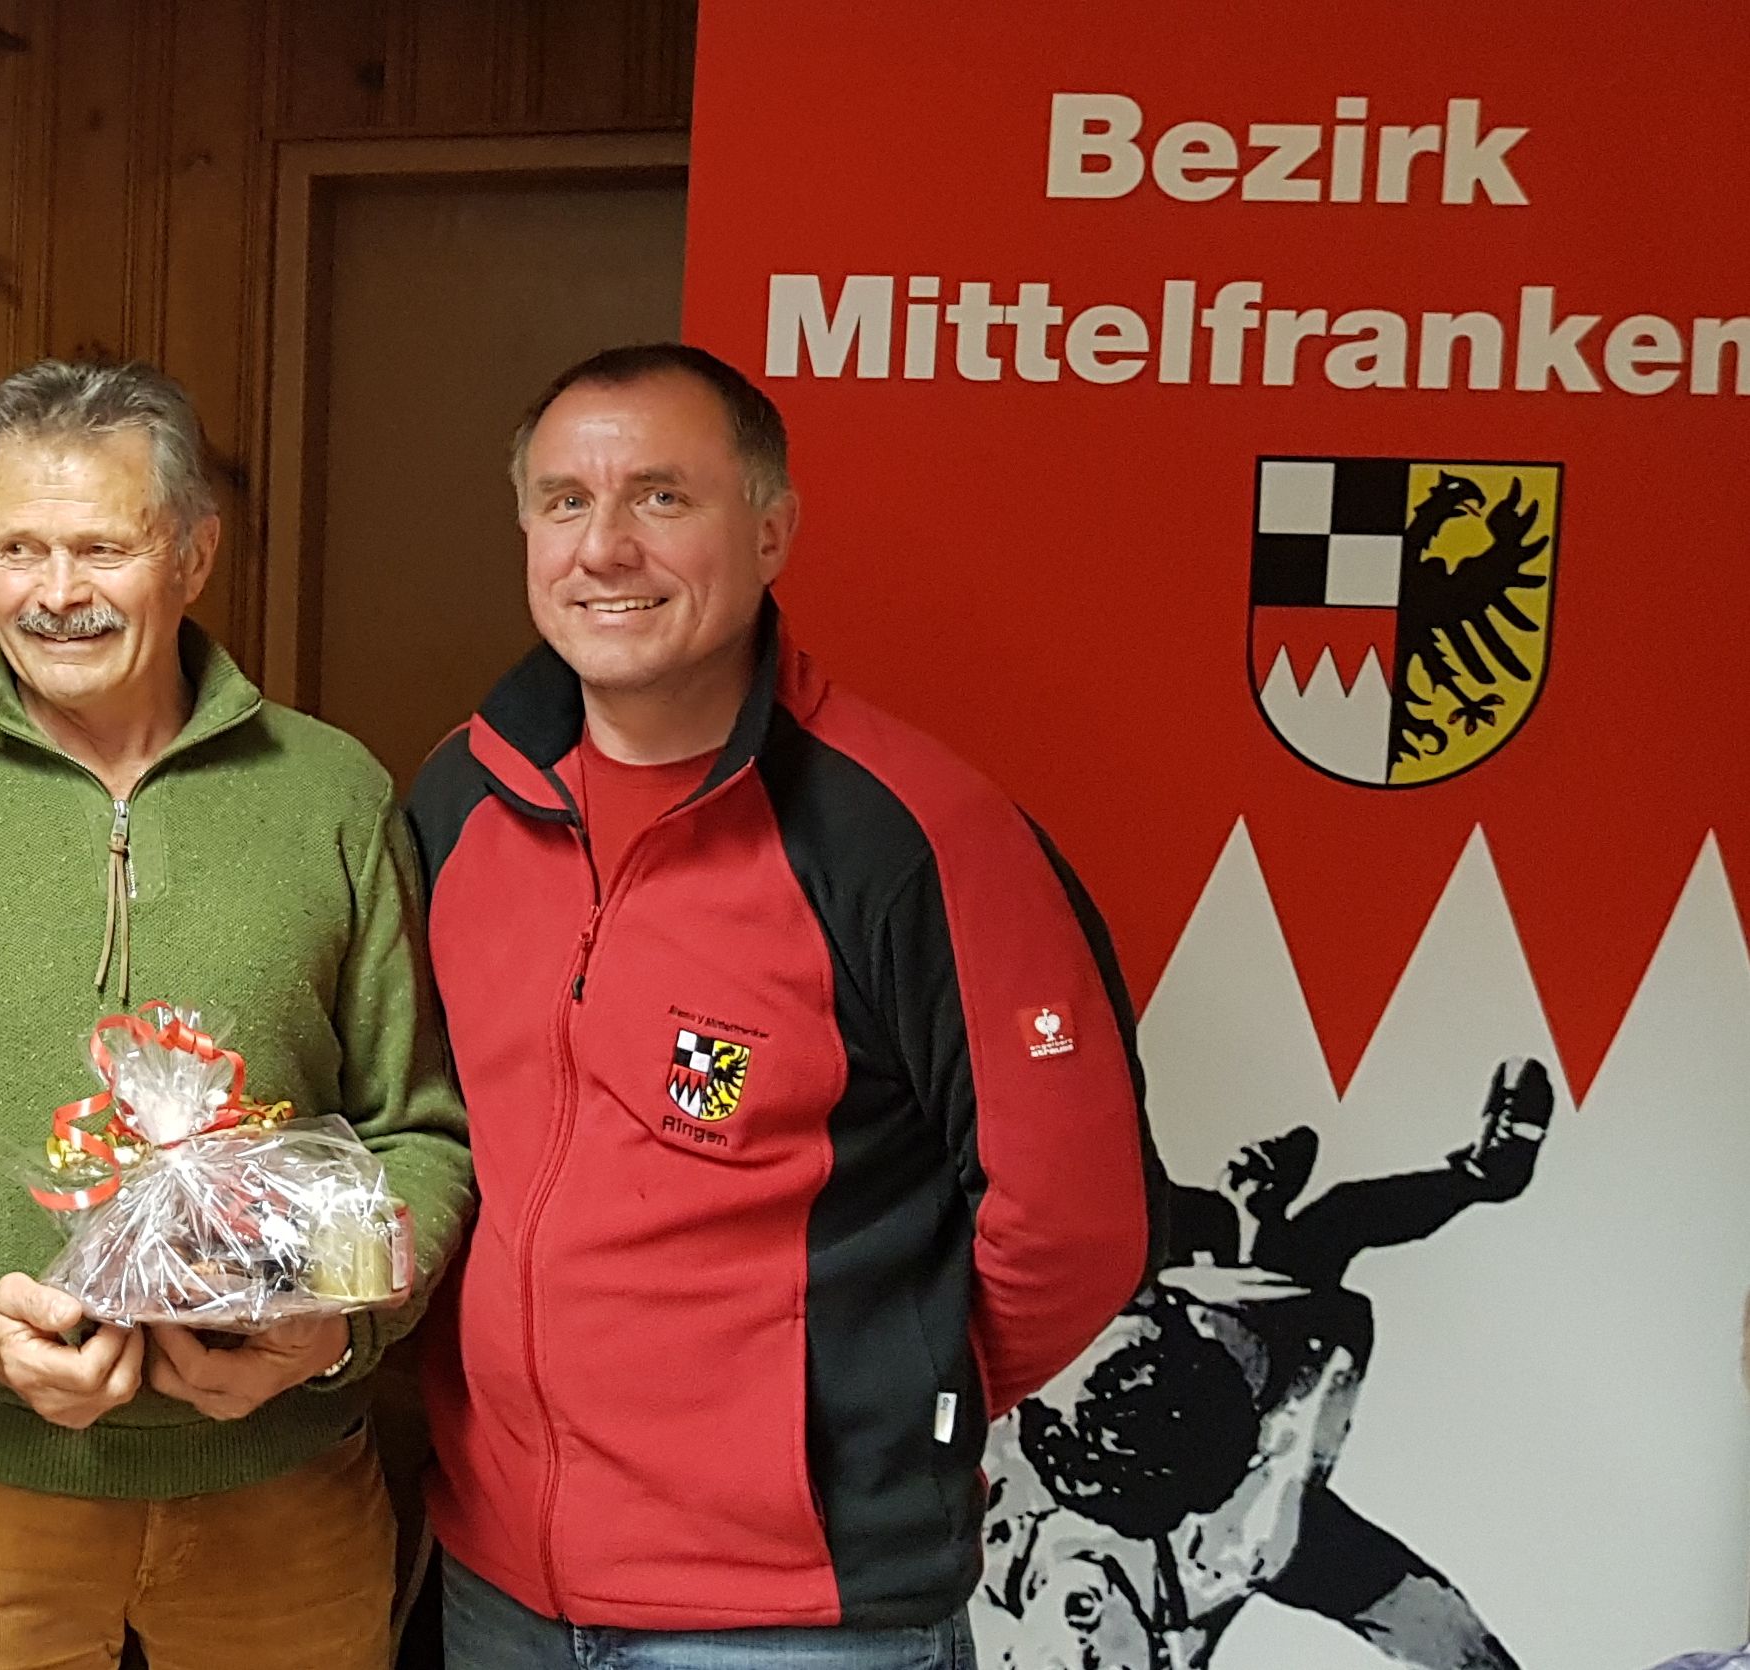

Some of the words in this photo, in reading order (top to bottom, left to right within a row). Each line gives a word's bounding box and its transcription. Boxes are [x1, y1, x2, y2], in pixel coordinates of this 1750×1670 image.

[1045, 92, 1530, 206] Bezirk
[763, 272, 1750, 396] Mittelfranken
[661, 1115, 729, 1147] Ringen
